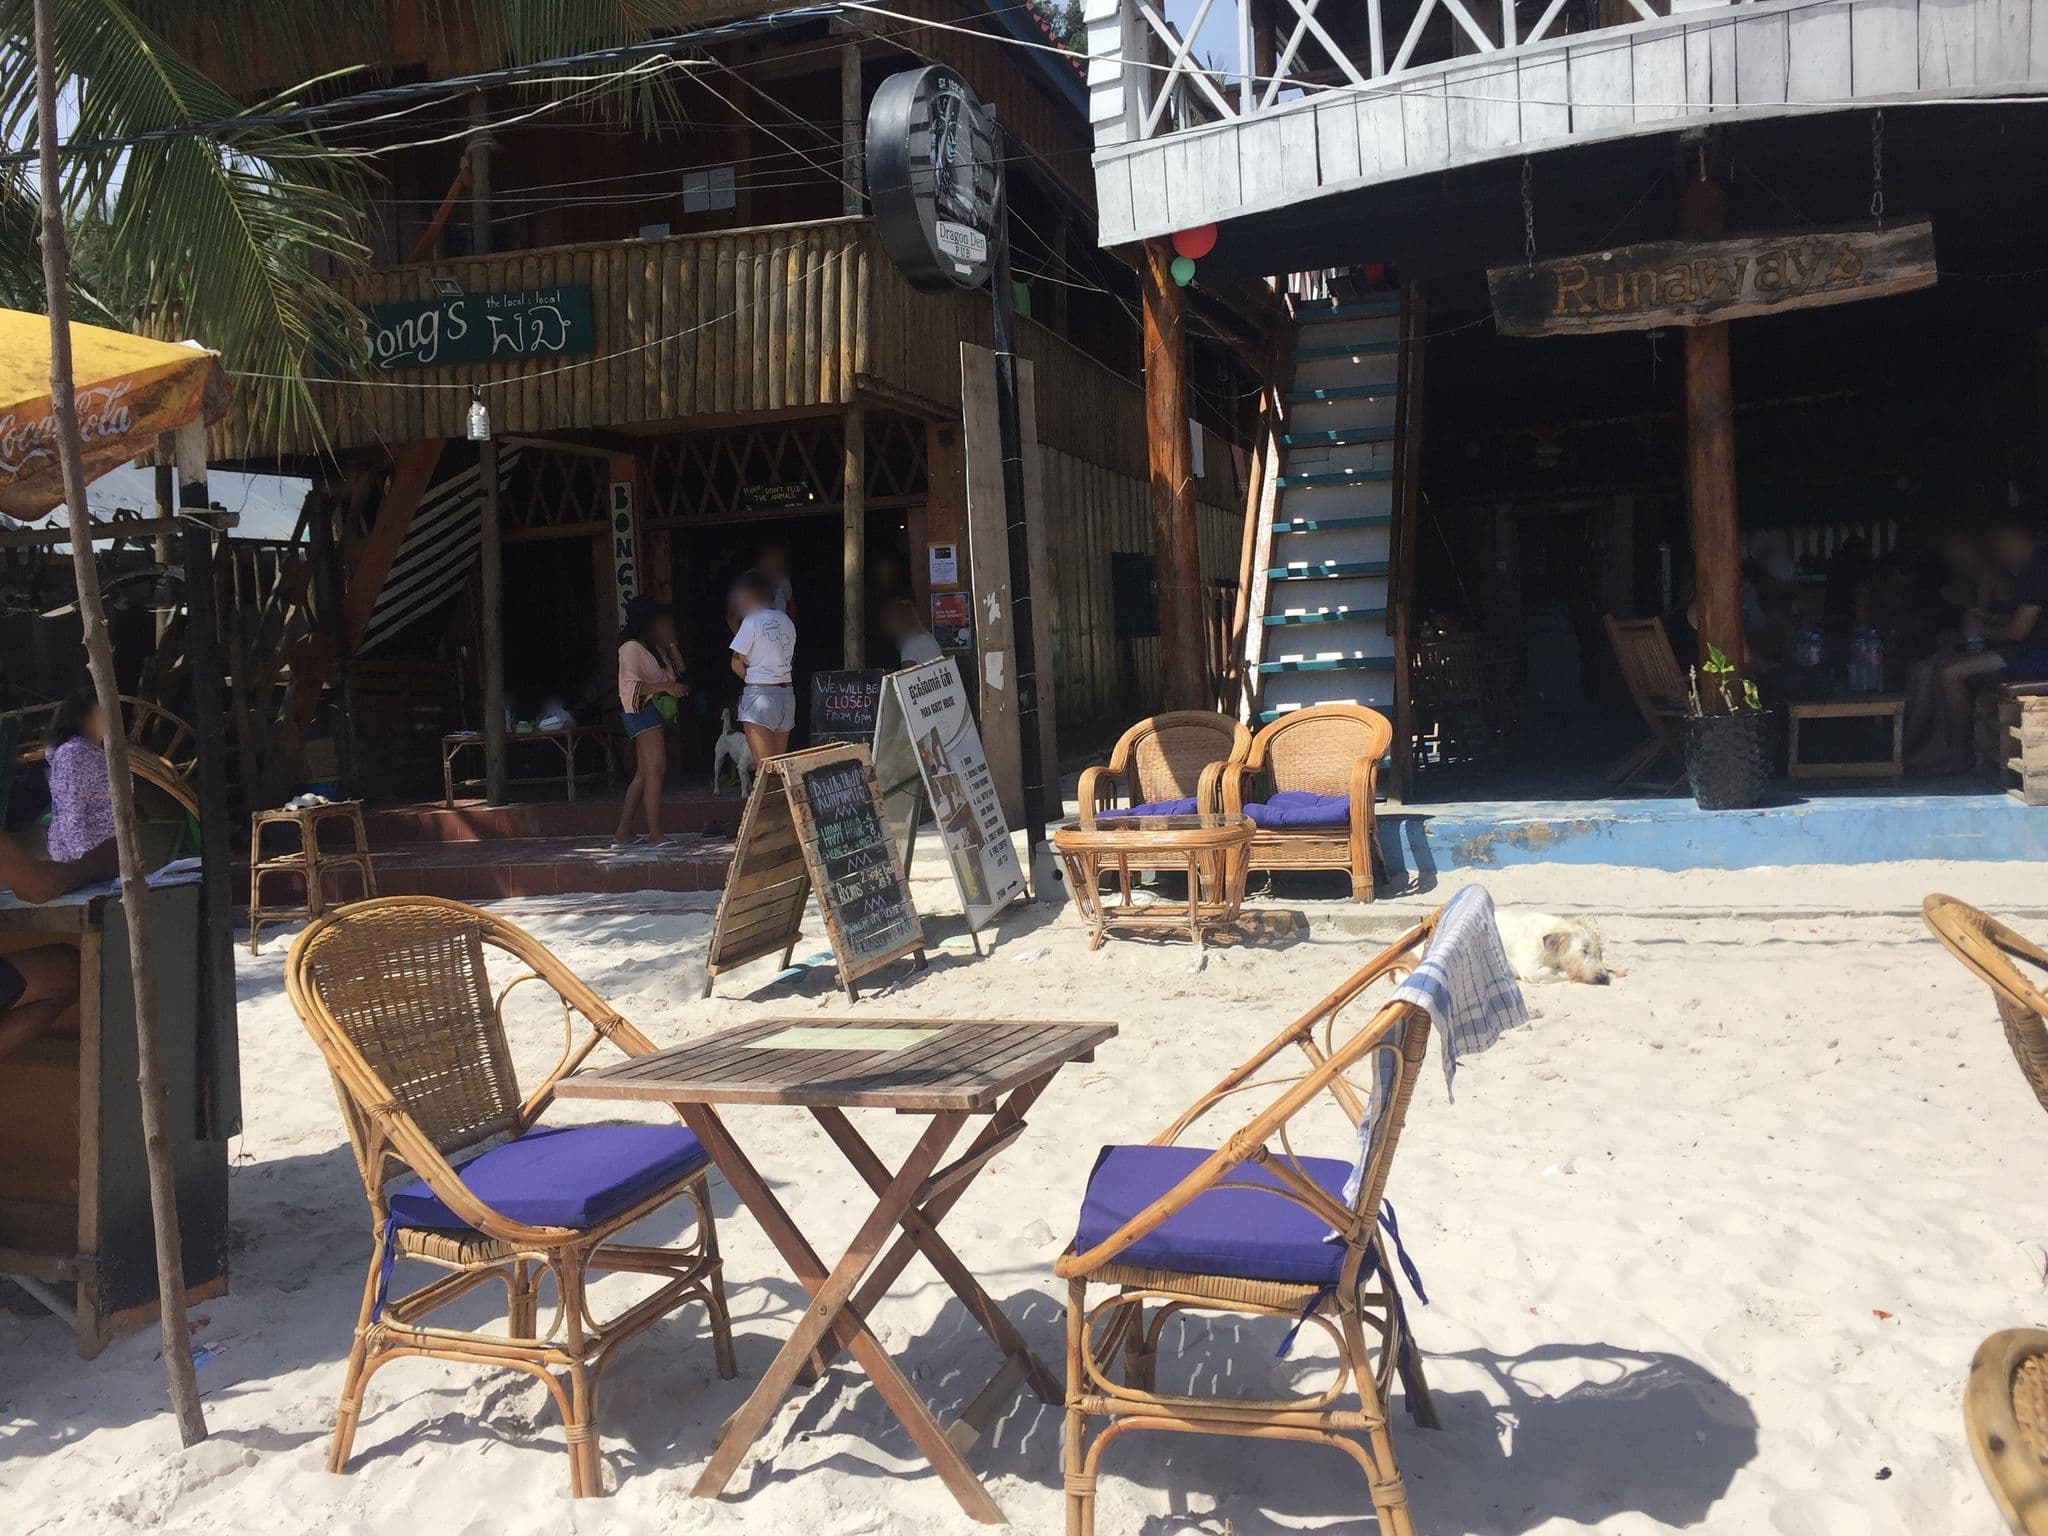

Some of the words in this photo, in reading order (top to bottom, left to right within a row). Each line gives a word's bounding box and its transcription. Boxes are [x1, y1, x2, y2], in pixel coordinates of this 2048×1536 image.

[939, 223, 969, 246] Dragon
[970, 231, 985, 249] Den
[955, 245, 971, 259] PUB
[486, 295, 500, 308] the
[536, 289, 560, 304] local
[816, 675, 837, 694] WE
[840, 682, 862, 695] WILL
[865, 684, 878, 695] BE
[825, 695, 872, 709] CLOSED
